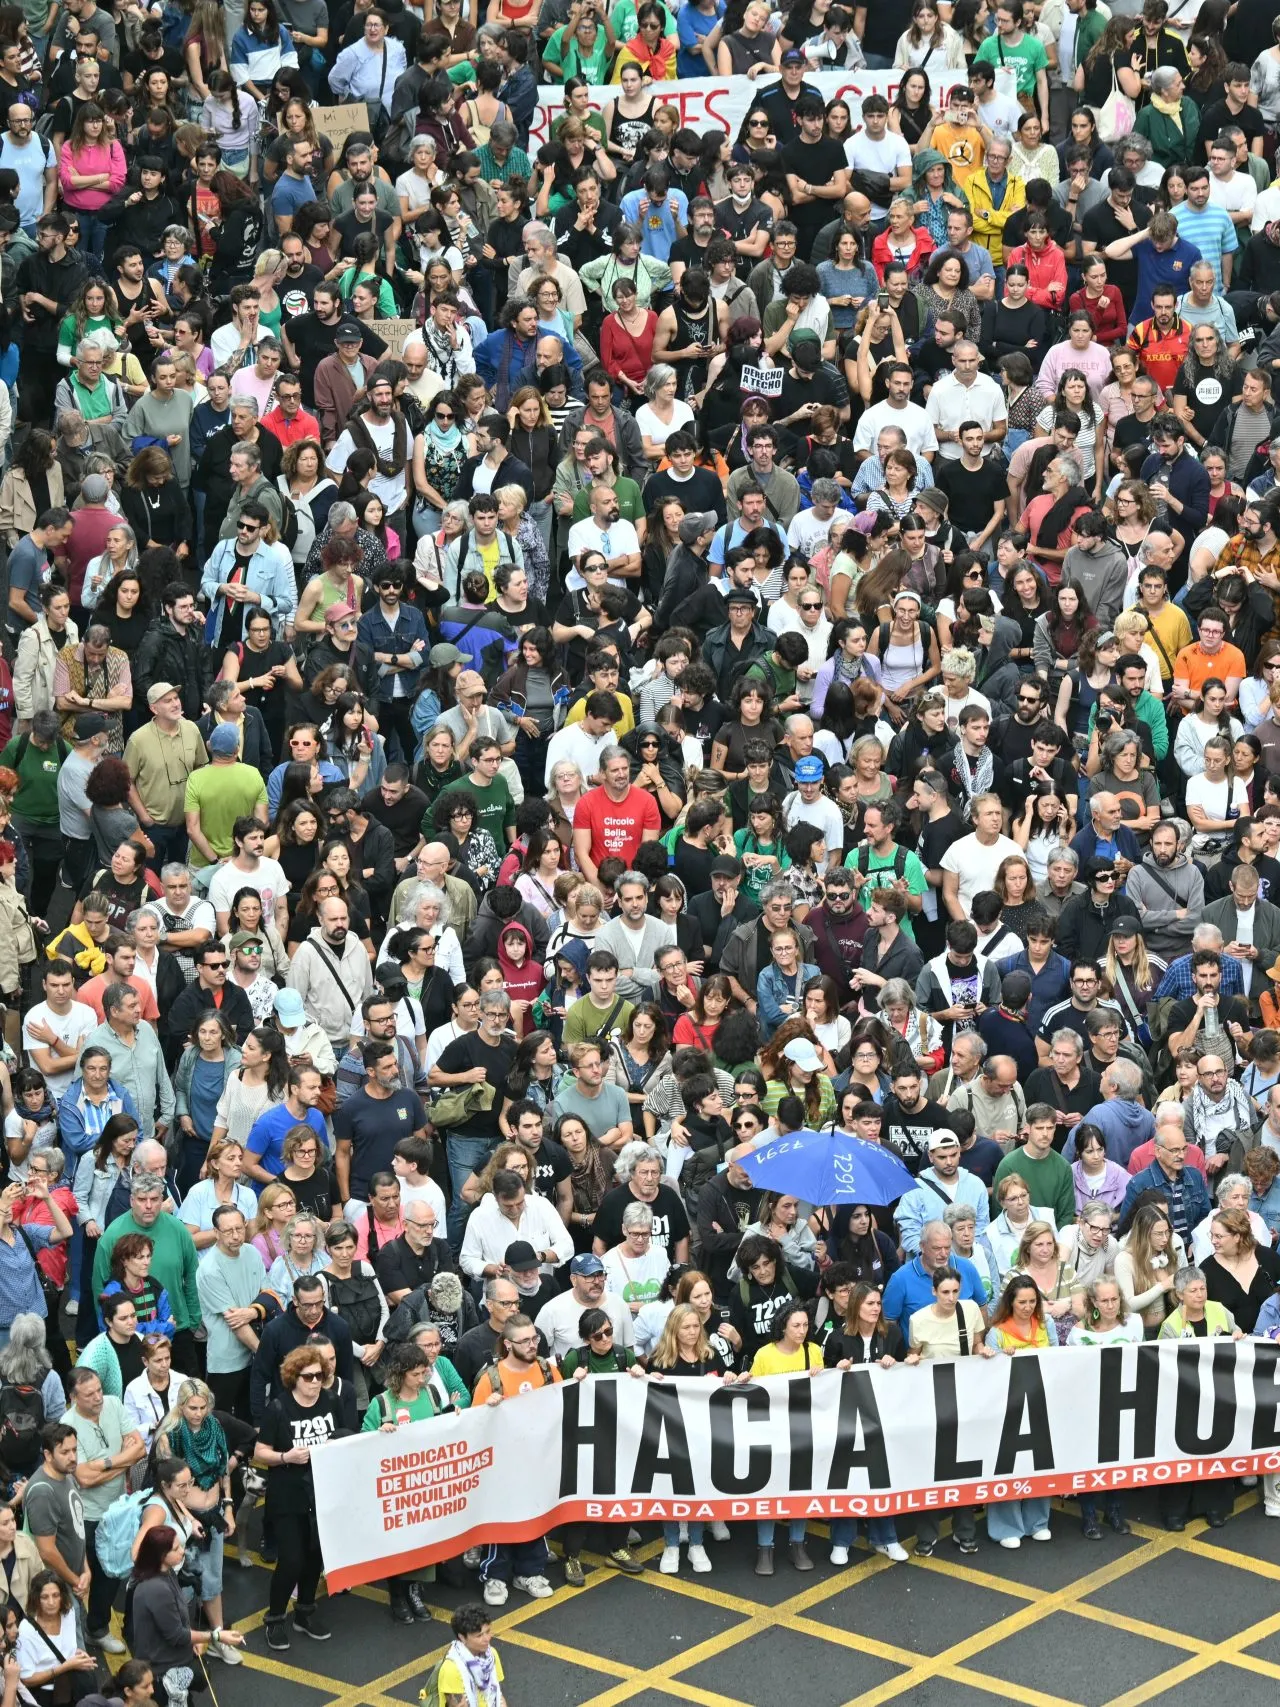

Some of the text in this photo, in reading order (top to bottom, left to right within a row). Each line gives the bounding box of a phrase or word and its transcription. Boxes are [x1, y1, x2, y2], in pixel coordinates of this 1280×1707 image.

[370, 323, 412, 336] ERECHOS
[1146, 353, 1185, 362] ARAGN
[742, 375, 749, 384] A
[751, 377, 781, 390] TECHO
[743, 366, 782, 381] DERECHO
[604, 817, 635, 825] Circolo
[756, 1142, 806, 1165] 7291
[833, 1153, 857, 1196] 7291
[290, 1412, 335, 1439] 7291
[559, 1370, 891, 1499] HACIA
[932, 1355, 1055, 1482] LA
[380, 1440, 468, 1474] SINDICATO
[381, 1451, 490, 1495] DE INQUILINAS
[382, 1474, 480, 1514] E INQUILINOS
[586, 1502, 715, 1518] BAJADA
[732, 1499, 790, 1517] DEL
[806, 1488, 960, 1516] ALQUILER
[975, 1480, 1033, 1500] 50%
[384, 1496, 467, 1532] DE MADRID
